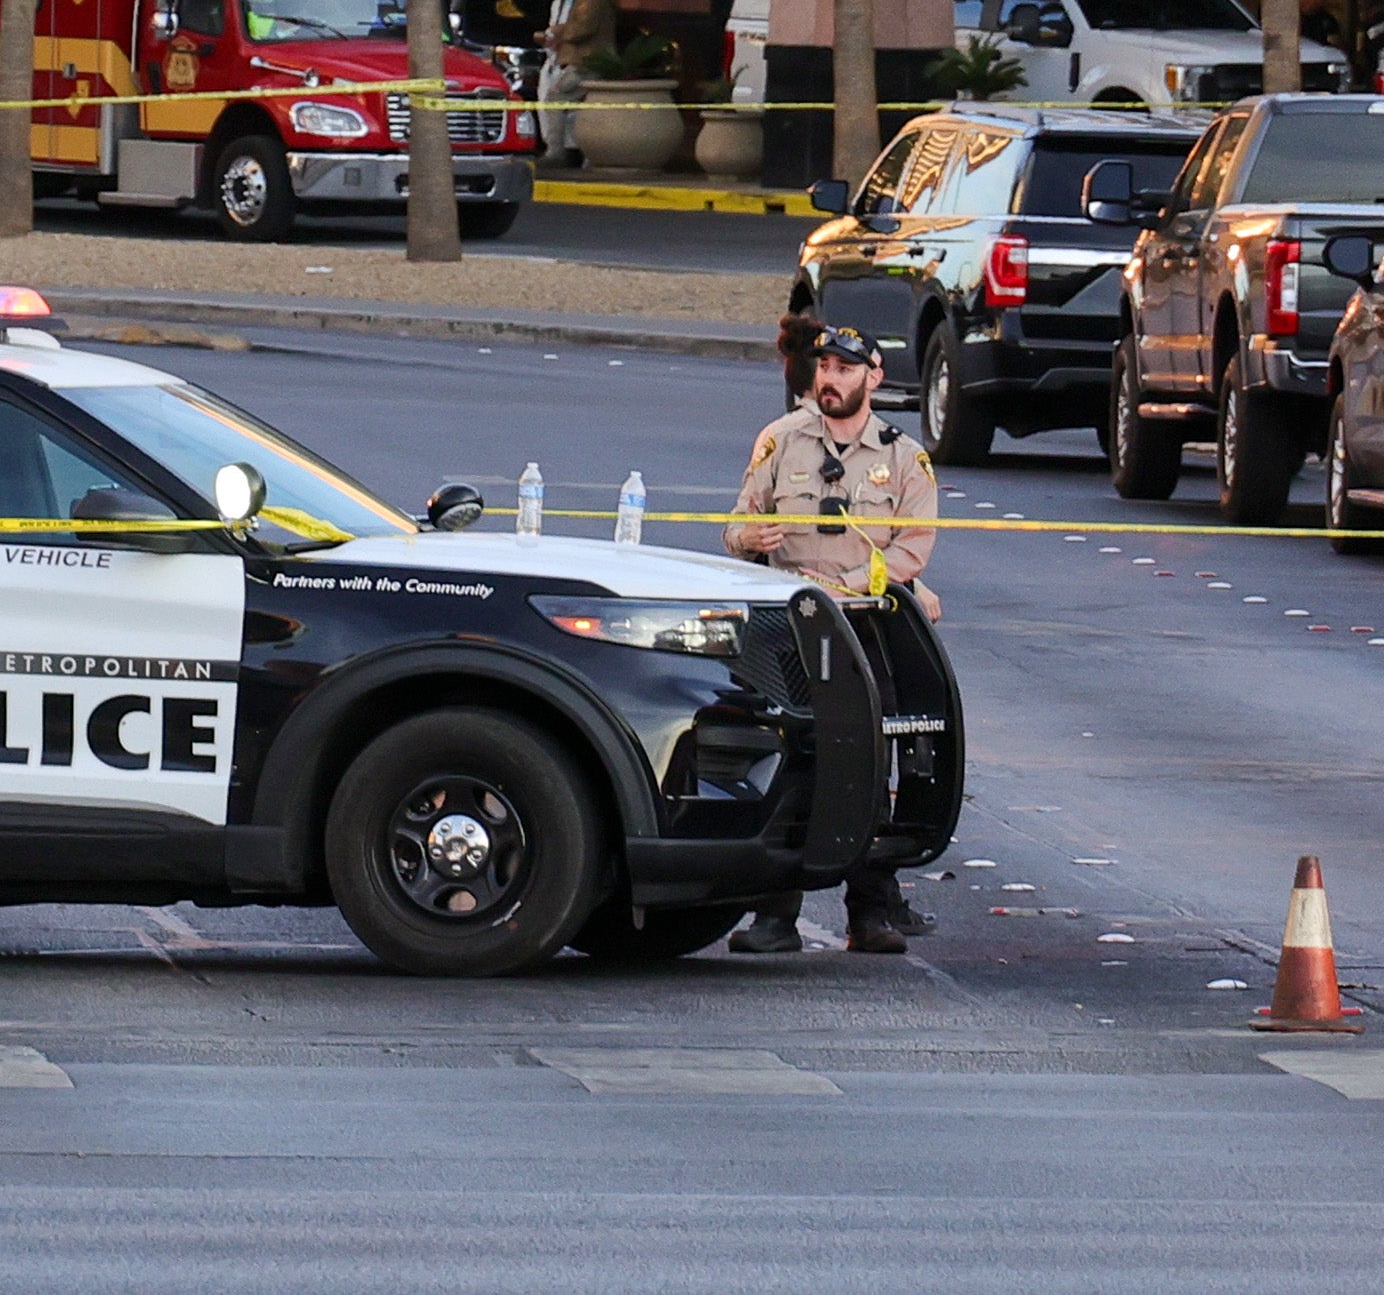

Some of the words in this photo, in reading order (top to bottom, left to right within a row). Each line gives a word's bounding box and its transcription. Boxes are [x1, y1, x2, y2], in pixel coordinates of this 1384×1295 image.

[5, 548, 113, 569] VEHICLE
[273, 573, 336, 589] Partners
[339, 576, 372, 591] with
[376, 578, 401, 592] the
[405, 578, 494, 600] Community
